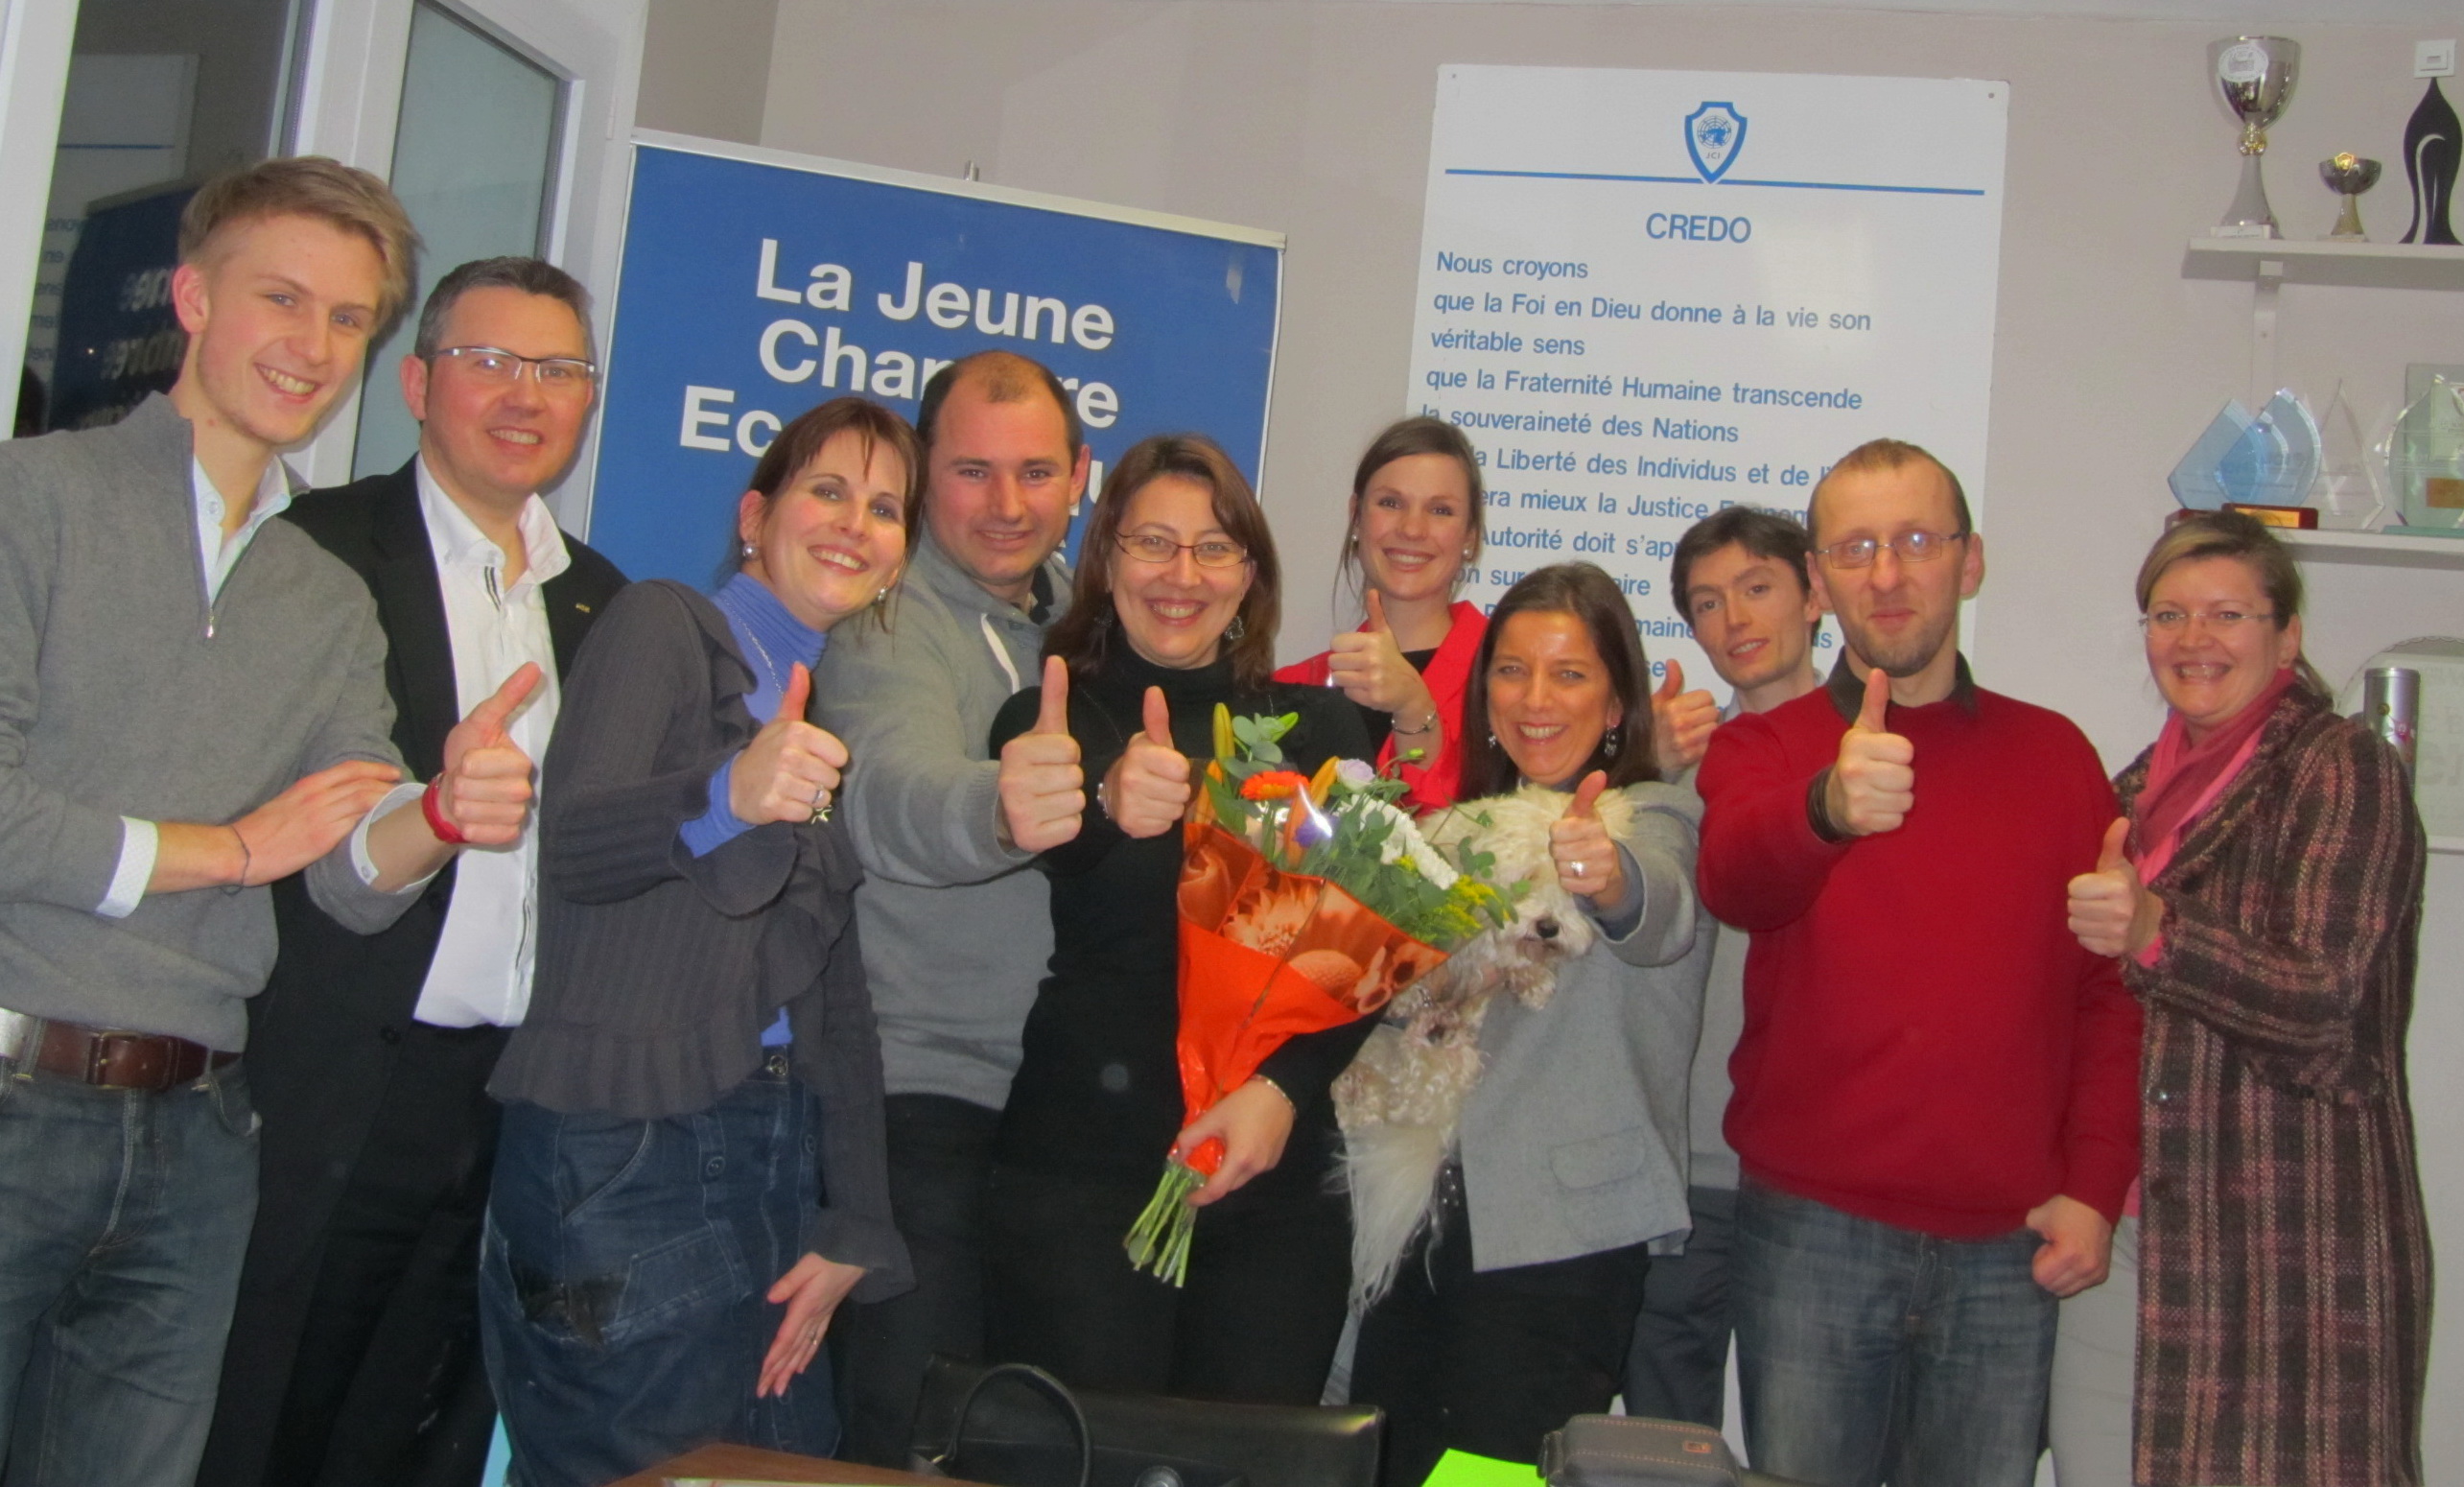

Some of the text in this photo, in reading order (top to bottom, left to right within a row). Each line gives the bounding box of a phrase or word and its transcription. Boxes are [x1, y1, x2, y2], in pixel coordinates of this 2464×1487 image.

[1646, 212, 1751, 245] CREDO
[1437, 252, 1589, 280] Nous croyons
[755, 238, 1115, 350] La Jeune
[1434, 293, 1871, 331] que la Foi en Dieu donne à la vie son
[1432, 329, 1585, 356] véritable sens
[1426, 368, 1863, 410] que la Fraternité Humaine transcende
[1450, 411, 1592, 435] souveraineté
[1602, 415, 1643, 436] des
[1653, 417, 1739, 443] Nations
[1496, 448, 1577, 472] Liberté
[1586, 453, 1628, 476] des
[1637, 456, 1737, 483] Individus
[1748, 463, 1771, 484] et
[1780, 464, 1811, 486] de
[1520, 490, 1587, 512] mieux
[1597, 492, 1617, 514] la
[1627, 495, 1710, 520] Justice
[1573, 531, 1616, 554] doit
[1490, 569, 1526, 586] sur
